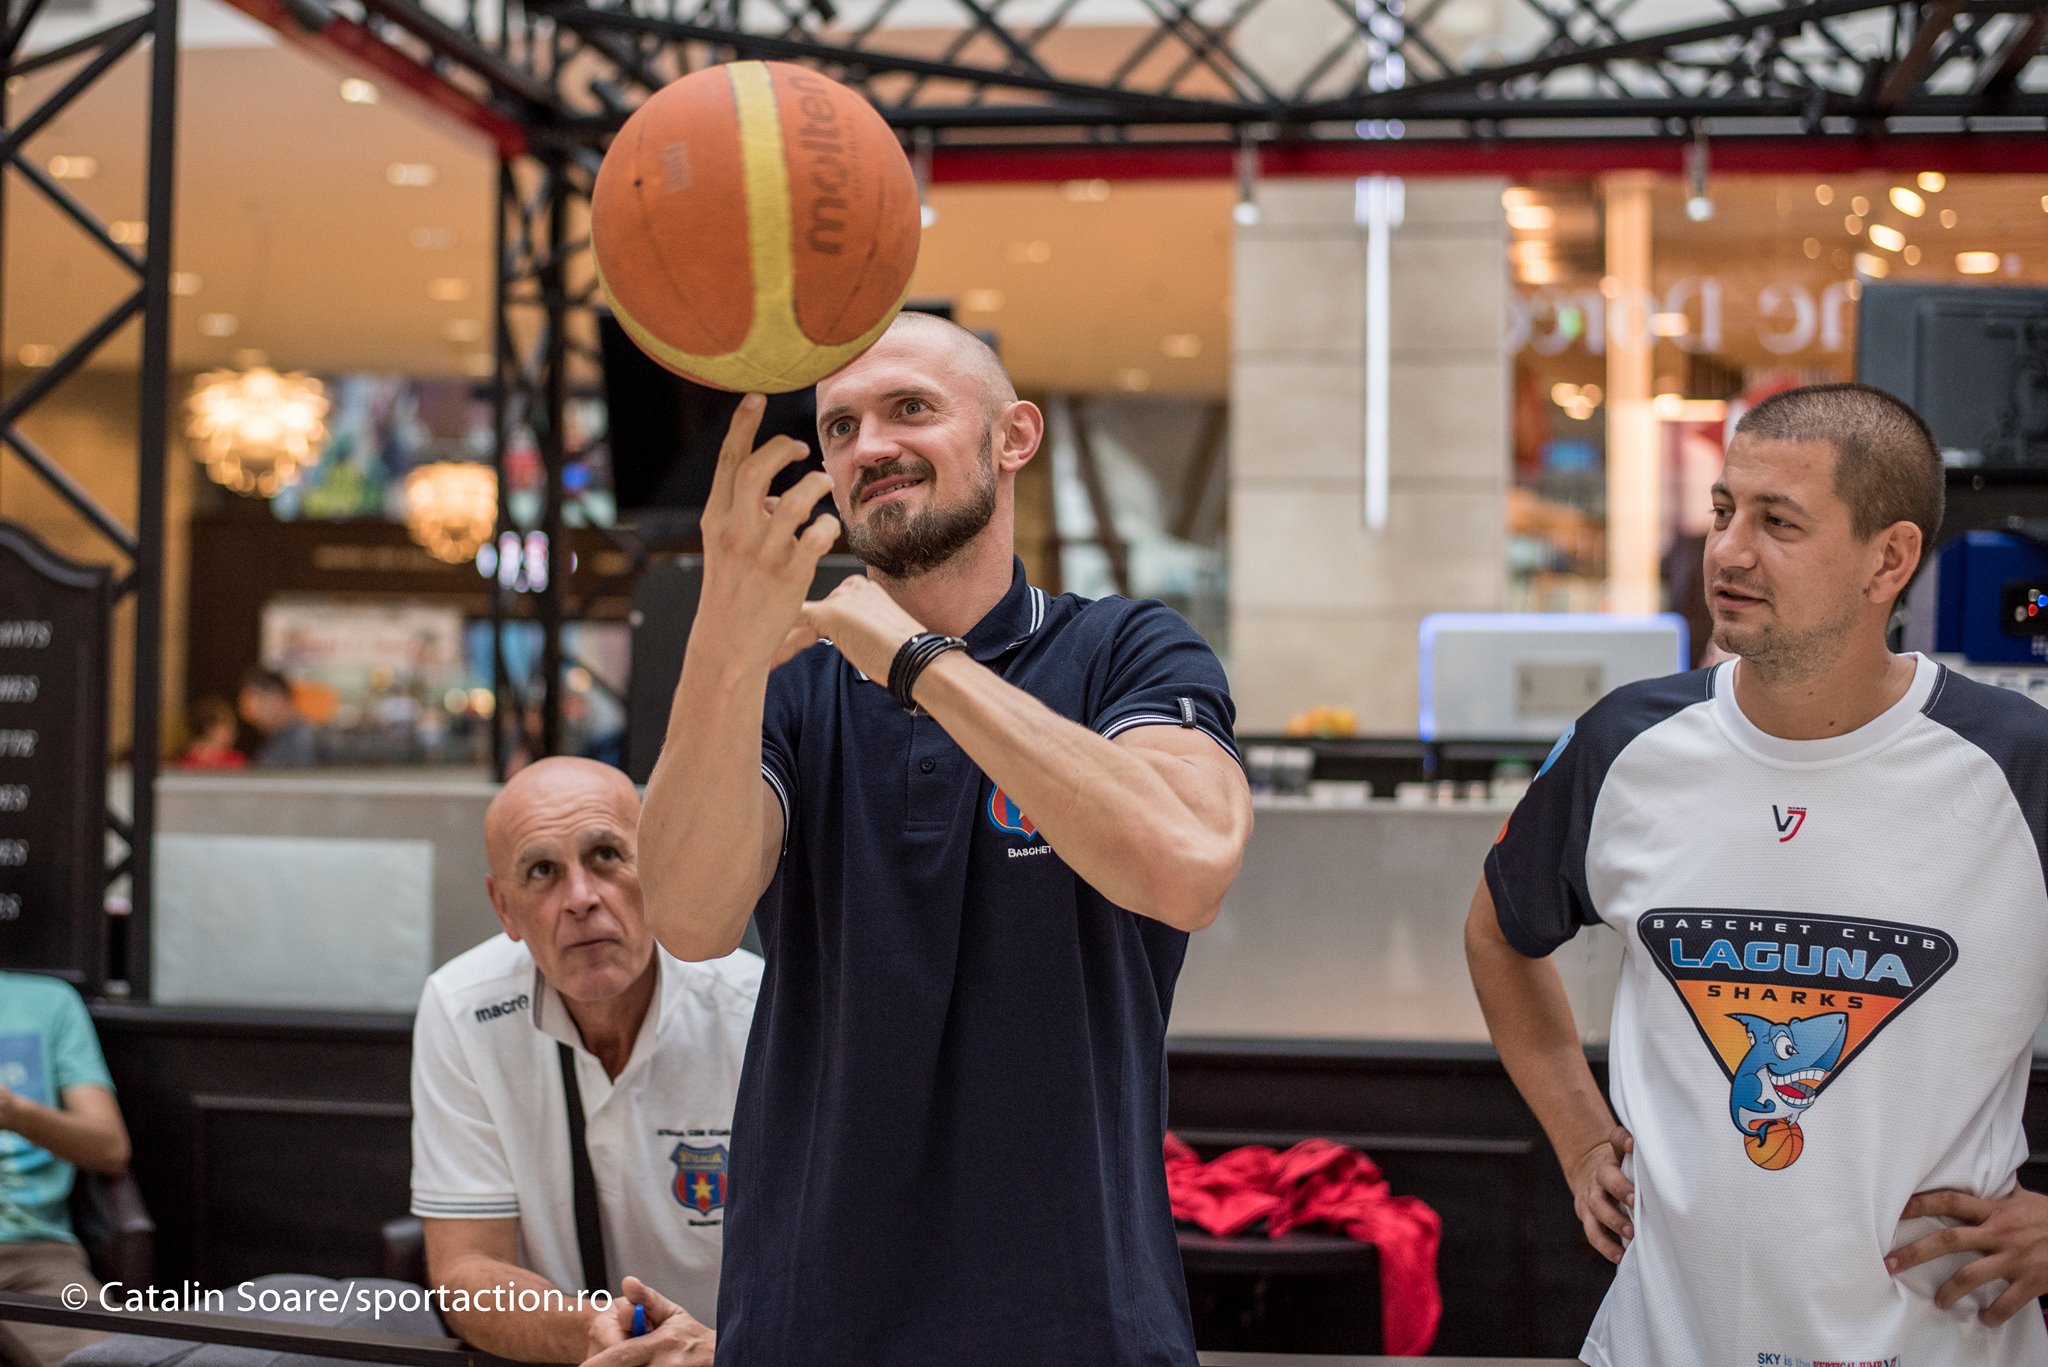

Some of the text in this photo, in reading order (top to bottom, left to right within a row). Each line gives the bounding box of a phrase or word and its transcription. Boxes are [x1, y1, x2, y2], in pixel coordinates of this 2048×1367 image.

[788, 75, 849, 256] molten
[1653, 919, 1935, 950] BASCHET CLUB
[1669, 938, 1913, 987] LAGUNA
[1707, 985, 1863, 1009] SHARKS
[1757, 1352, 1781, 1365] SKY
[1784, 1355, 1793, 1366] is
